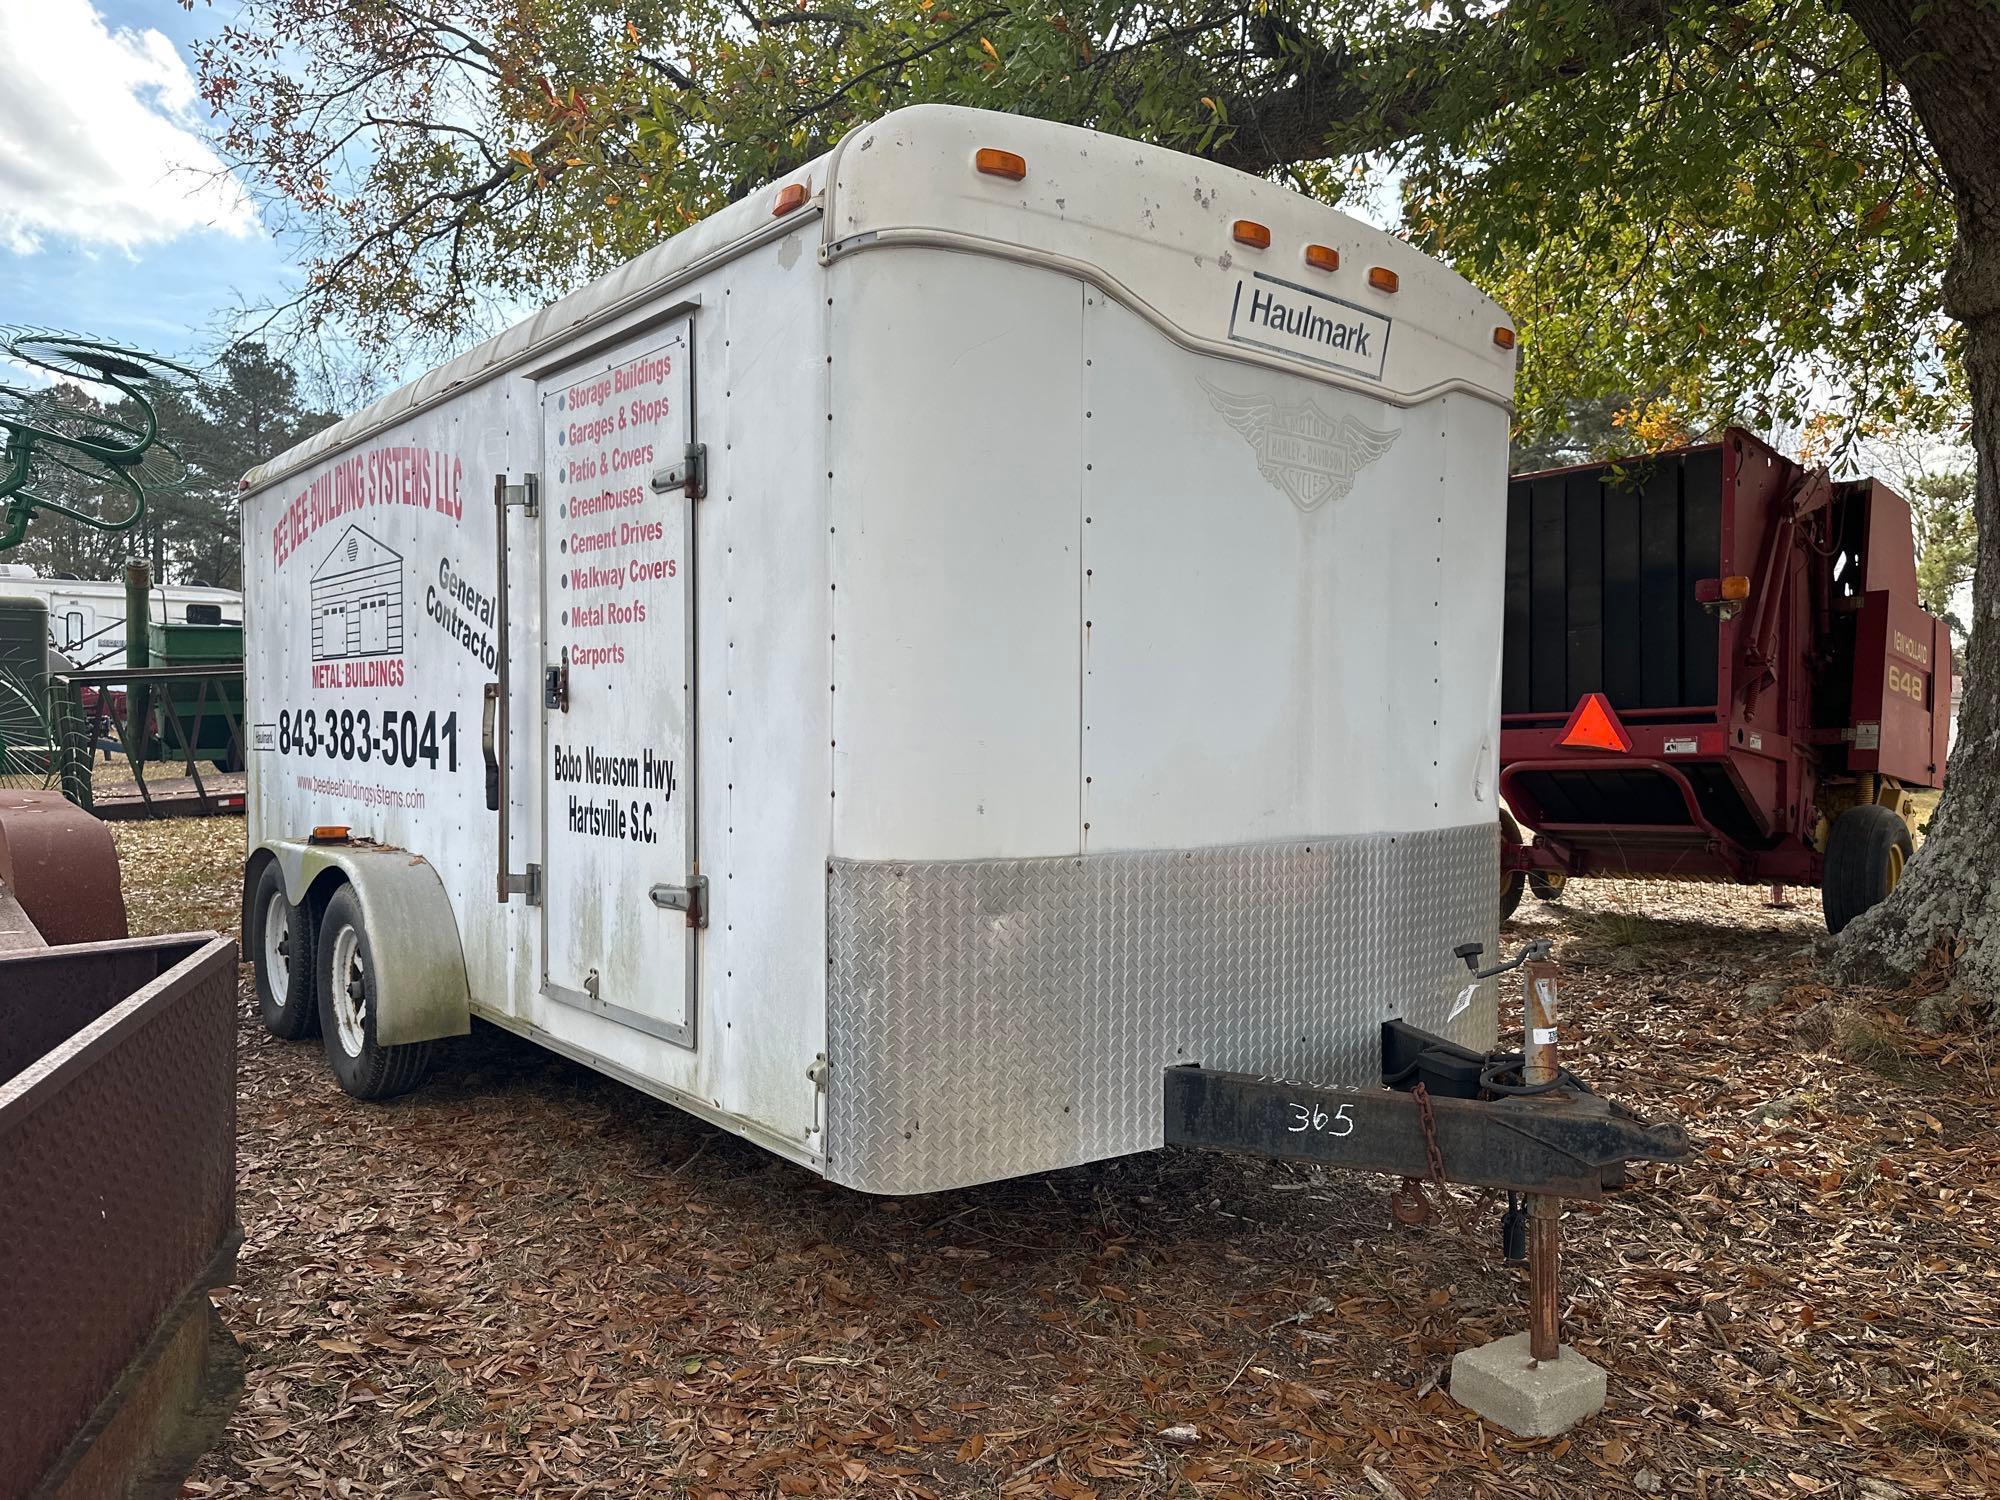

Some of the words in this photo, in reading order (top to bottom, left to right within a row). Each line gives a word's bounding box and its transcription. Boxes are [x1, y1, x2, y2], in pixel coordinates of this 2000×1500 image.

[1249, 289, 1372, 356] Haulmark
[568, 379, 611, 412] Storage
[614, 355, 671, 394] Buildings
[569, 415, 614, 446] Garages
[618, 405, 627, 431] &
[631, 396, 669, 426] Shops
[569, 456, 596, 484] Patio
[599, 451, 608, 476] &
[612, 444, 654, 472] Covers
[273, 514, 289, 574] PEE
[290, 490, 309, 553] DEE
[311, 454, 365, 534] BUILDING
[368, 447, 431, 509] SYSTEMS
[435, 451, 463, 521] LLC
[570, 485, 644, 519] Greenhouses
[570, 526, 617, 555] Cement
[620, 520, 663, 545] Drives
[439, 557, 496, 629] General
[570, 566, 625, 591] Walkway
[629, 559, 677, 583] Covers
[571, 604, 604, 628] Metal
[607, 599, 646, 625] Roofs
[312, 665, 342, 689] METAL
[345, 659, 404, 688] BUILDINGS
[571, 643, 625, 670] Carports
[1888, 665, 1922, 702] 648
[279, 709, 457, 773] 843-383-5041
[554, 744, 582, 783] Bobo
[585, 746, 638, 787] Newsom
[643, 748, 676, 802] Hwy.
[569, 794, 626, 840] Hartsville
[630, 800, 657, 844] S.C.
[1288, 1103, 1354, 1136] 365
